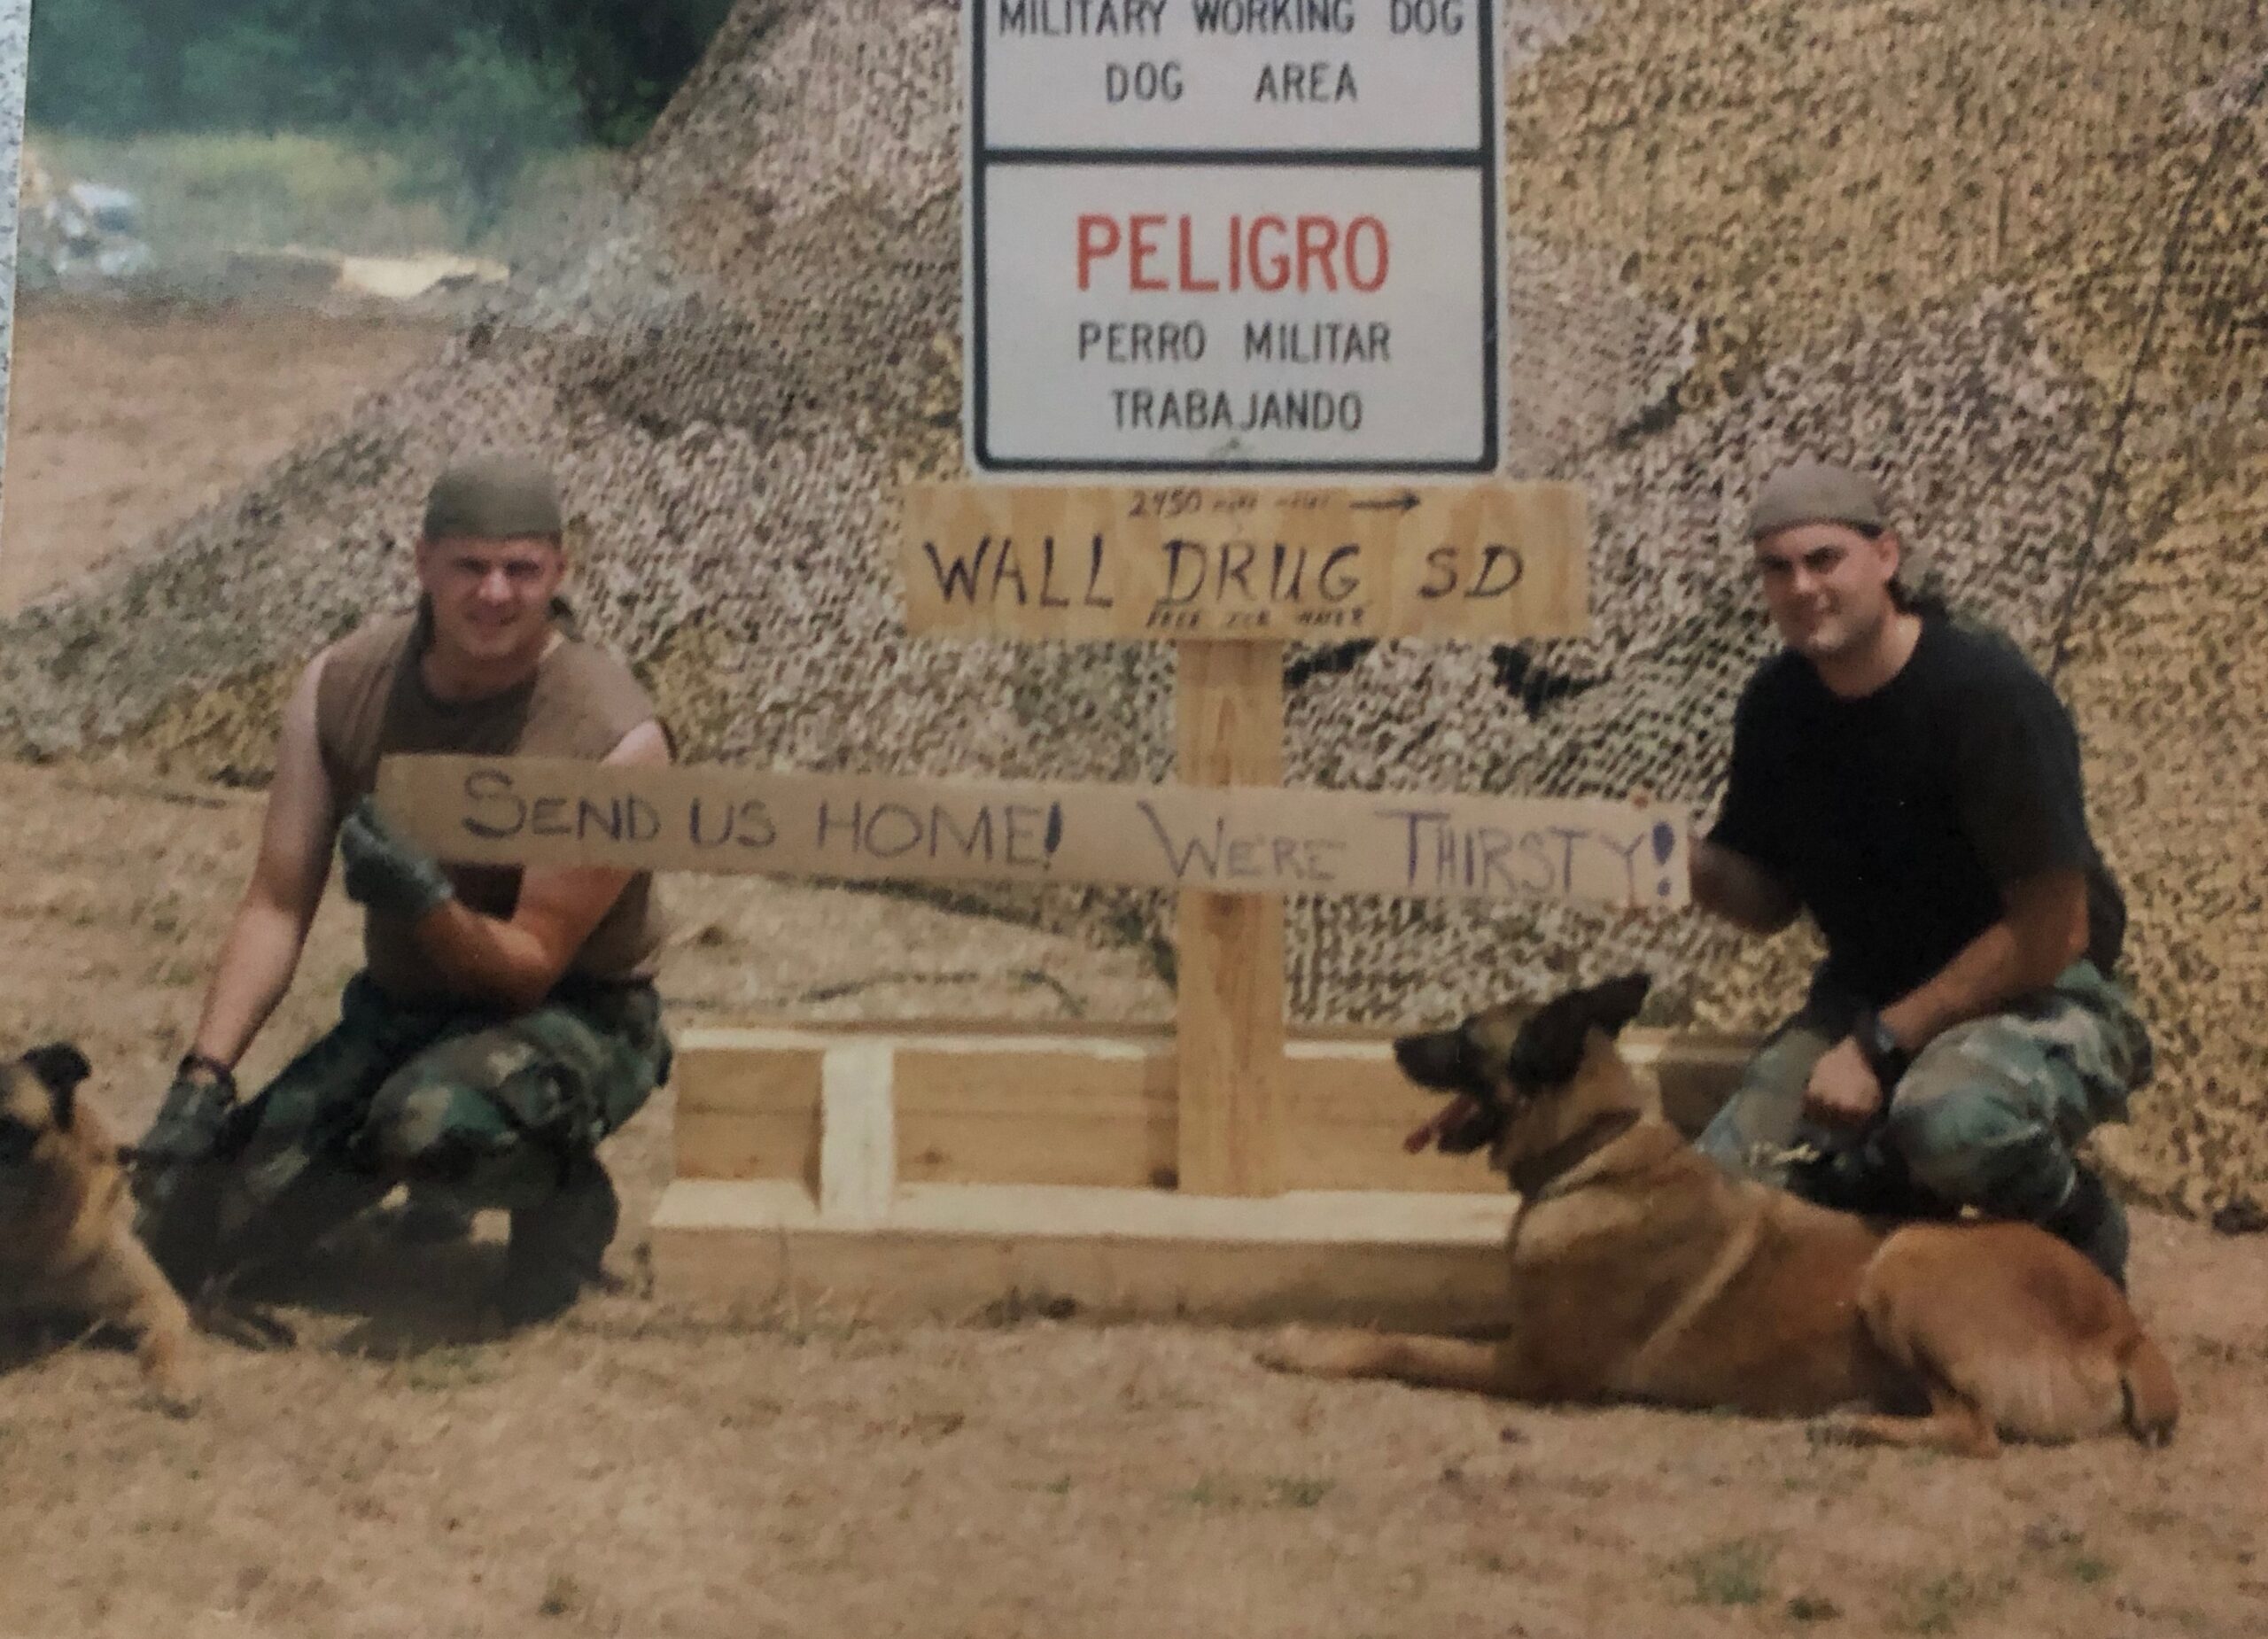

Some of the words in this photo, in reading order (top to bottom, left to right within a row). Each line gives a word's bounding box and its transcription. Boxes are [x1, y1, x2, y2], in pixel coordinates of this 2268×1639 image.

[999, 0, 1167, 36] MILITARY
[1193, 0, 1355, 35] WORKING
[1389, 0, 1464, 35] DOG
[1106, 61, 1184, 103] DOG
[1254, 62, 1358, 103] AREA
[1076, 213, 1391, 292] PELIGRO
[1077, 320, 1207, 363] PERRO
[1243, 320, 1392, 364] MILITAR
[1110, 387, 1364, 431] TRABAJANDO
[923, 532, 1114, 608] WALL
[1154, 538, 1361, 606] DRUG
[1418, 543, 1525, 599] SD
[462, 767, 663, 839] SEND
[688, 799, 777, 849] US
[816, 799, 1063, 871] HOME!
[1373, 809, 1676, 907] THIRSTY!
